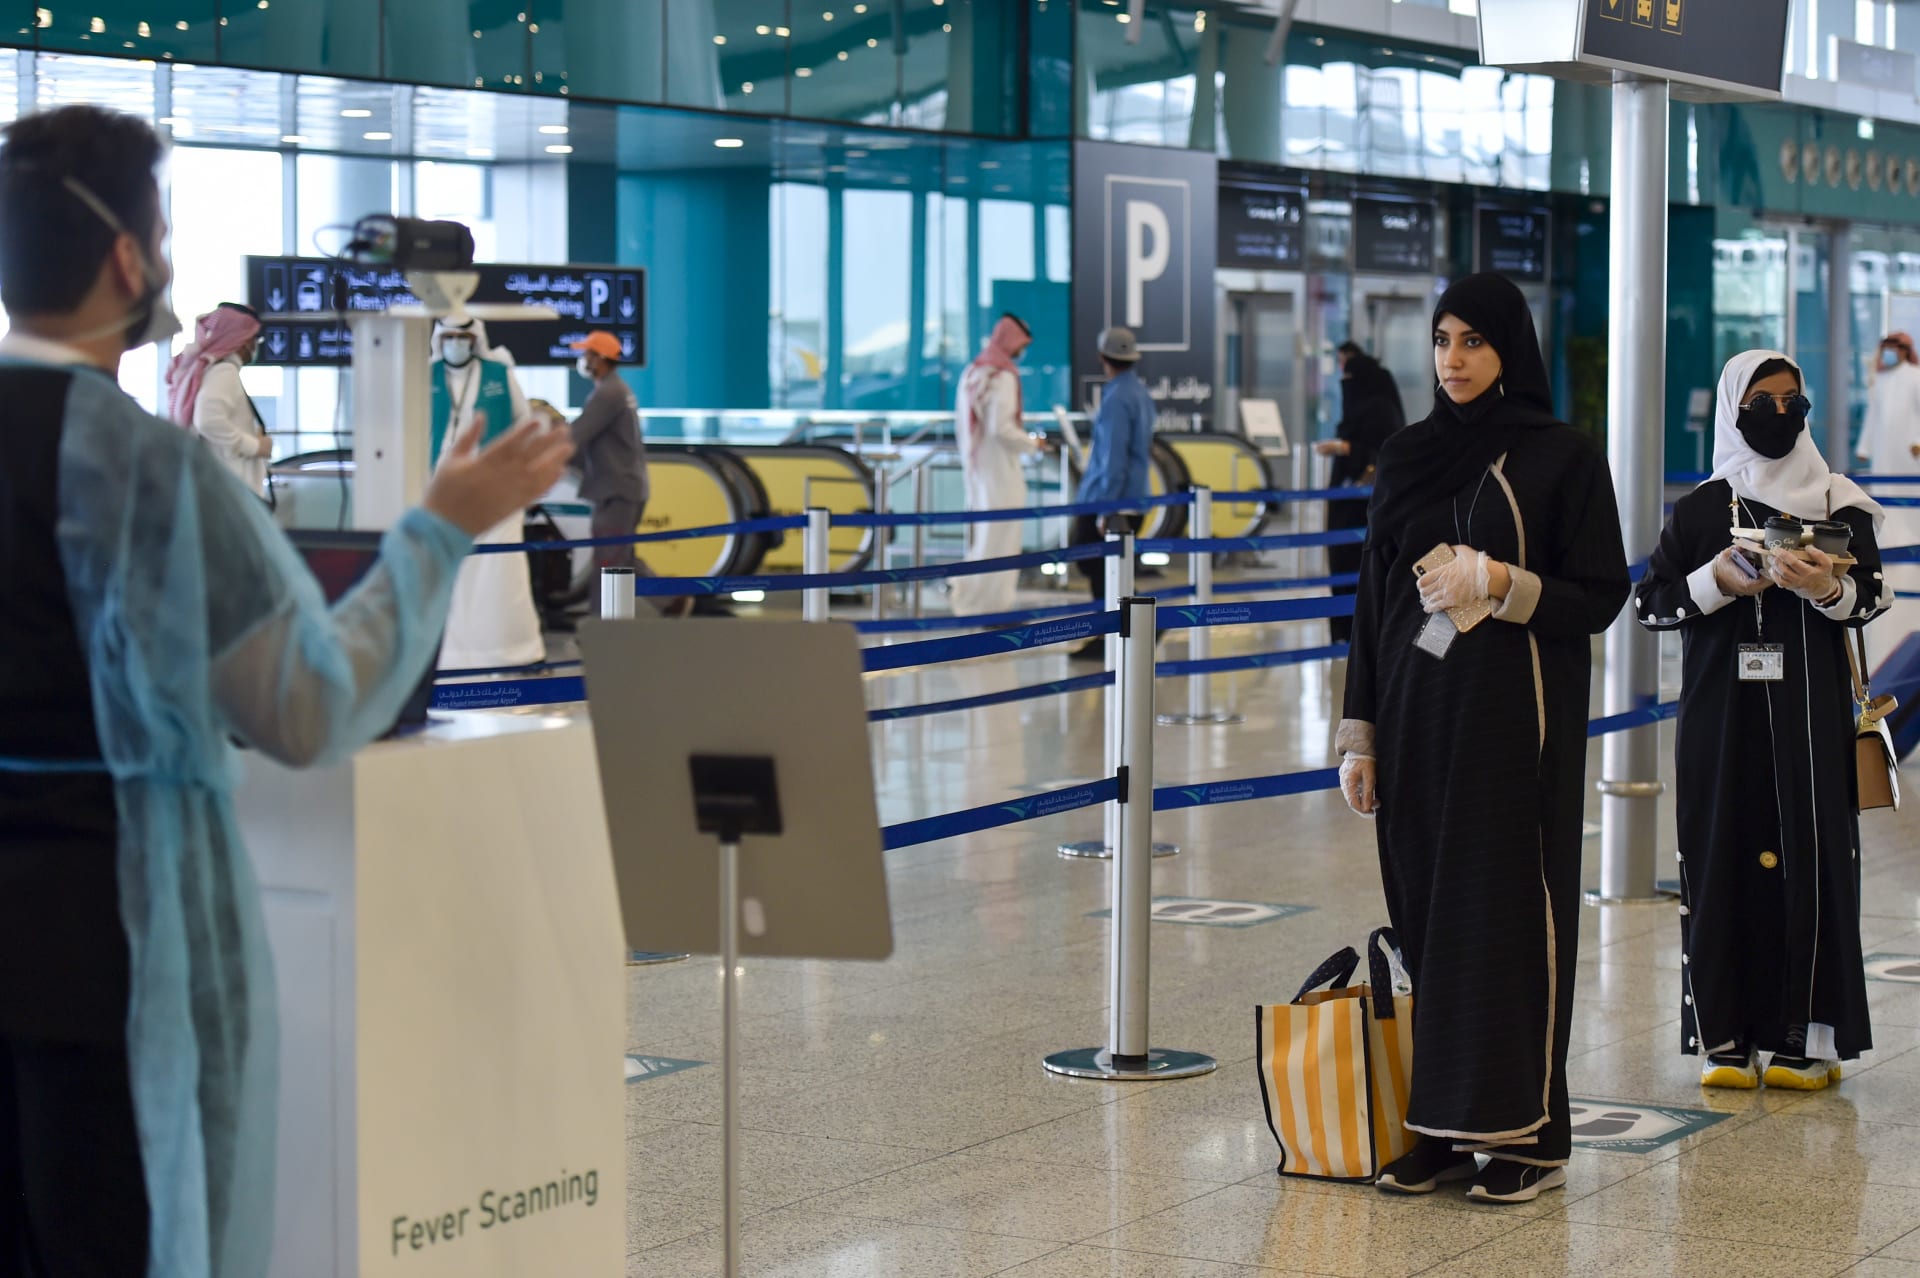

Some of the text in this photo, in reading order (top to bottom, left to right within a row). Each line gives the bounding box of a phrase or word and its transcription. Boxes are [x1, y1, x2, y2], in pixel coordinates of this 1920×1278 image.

[504, 272, 548, 294] السيارات
[1126, 200, 1171, 328] P
[590, 279, 609, 317] P
[391, 1169, 598, 1258] Fever Scanning
